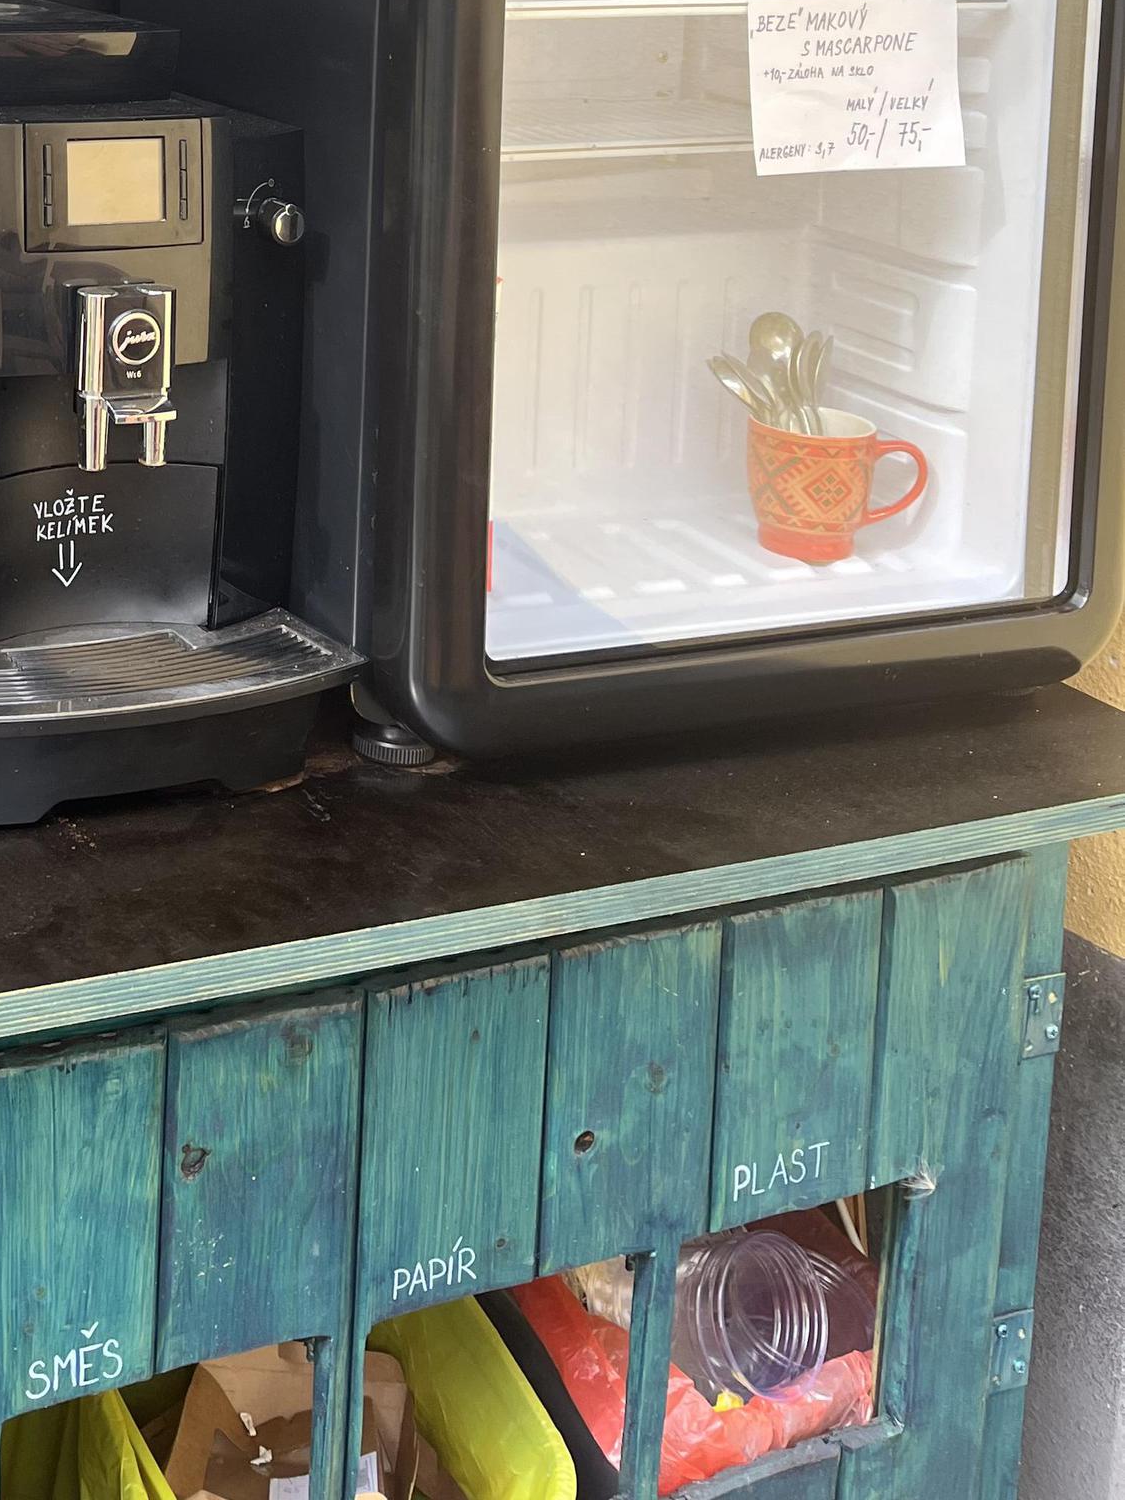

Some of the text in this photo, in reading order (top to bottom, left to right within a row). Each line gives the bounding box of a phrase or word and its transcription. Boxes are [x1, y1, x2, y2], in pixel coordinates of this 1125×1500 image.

[805, 3, 868, 32] MAKOVÝ
[801, 32, 918, 58] S MASCARPONE
[831, 66, 844, 78] NA
[849, 65, 875, 77] SKLO
[118, 329, 157, 353] jura
[33, 488, 106, 519] VLOŽTE
[35, 512, 114, 542] KELÍMEK
[733, 1141, 831, 1202] PLAST
[392, 1236, 477, 1300] PAPÍR
[25, 1322, 124, 1399] SMĚS
